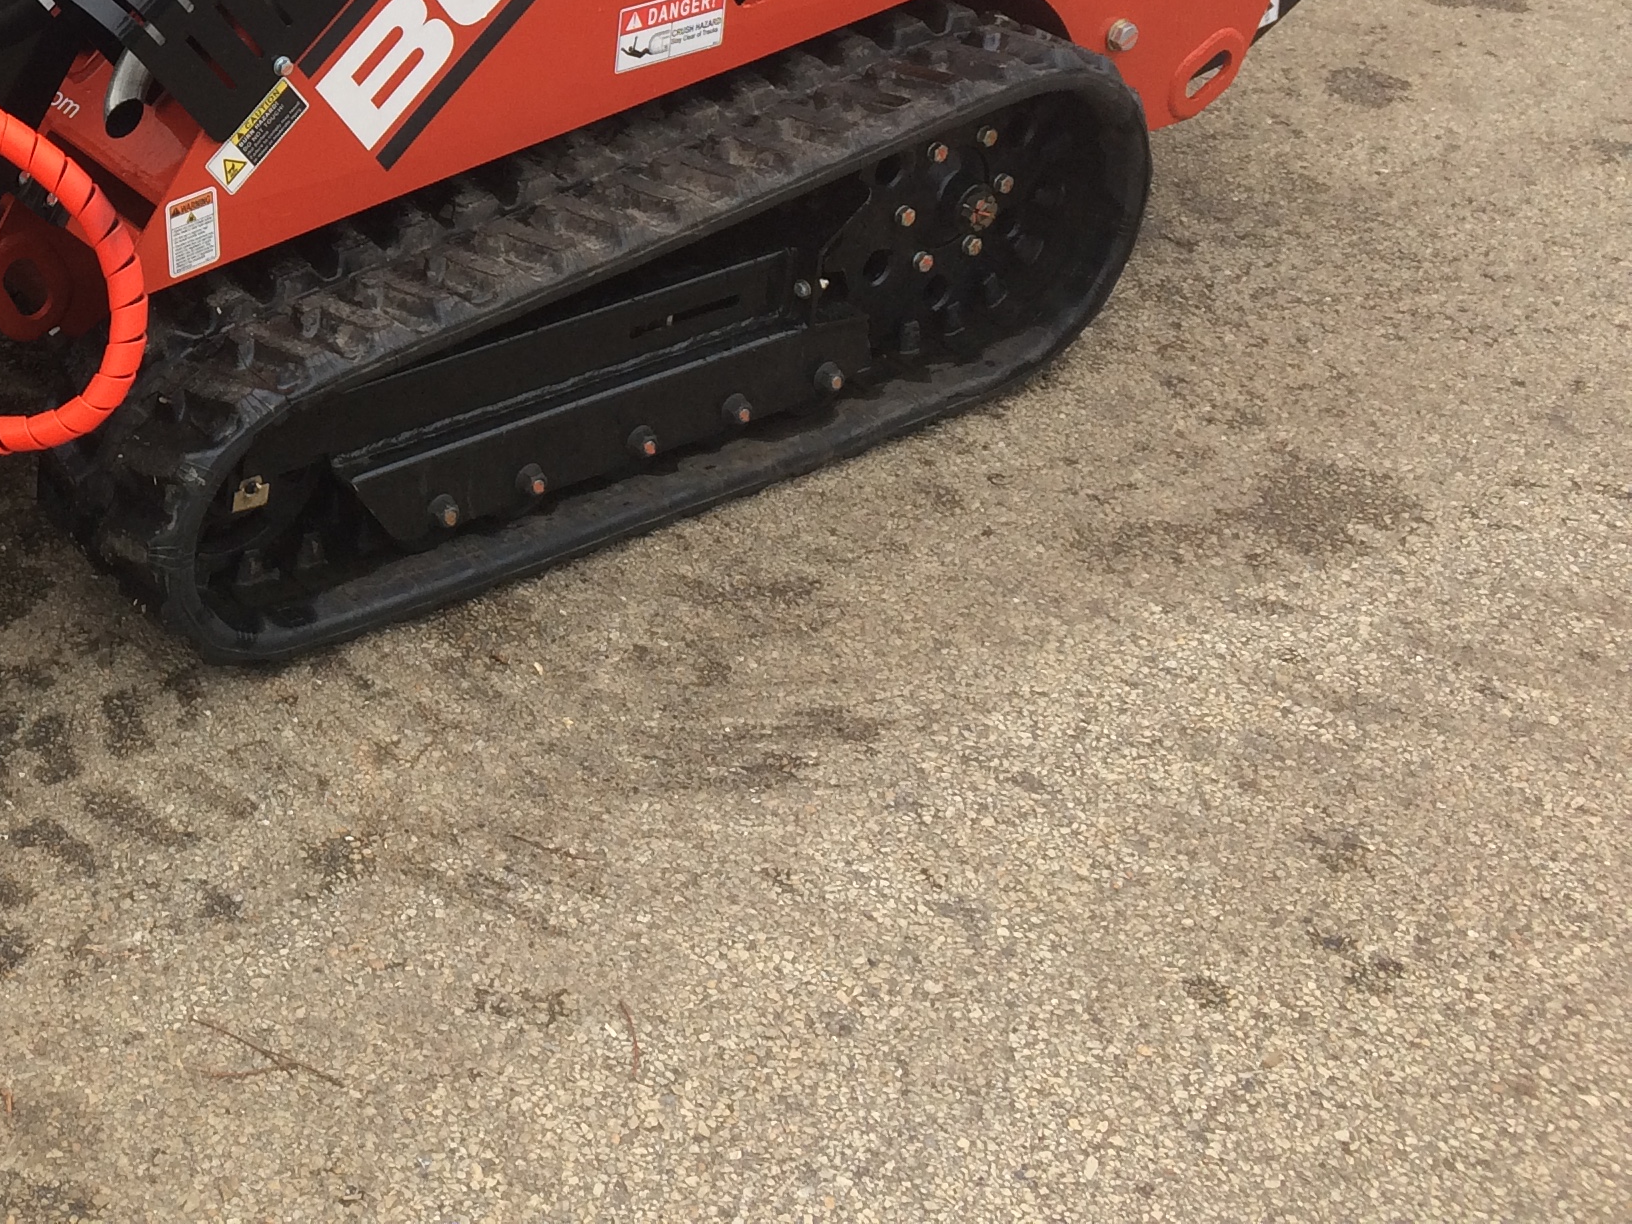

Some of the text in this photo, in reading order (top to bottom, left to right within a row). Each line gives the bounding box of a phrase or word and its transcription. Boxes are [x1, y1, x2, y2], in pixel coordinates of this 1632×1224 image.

[671, 22, 694, 38] CRUSH
[244, 89, 280, 129] CAUTION
[239, 127, 258, 148] BURN
[242, 104, 285, 152] DO NOT TOUCH!
[181, 195, 211, 213] WARNING
